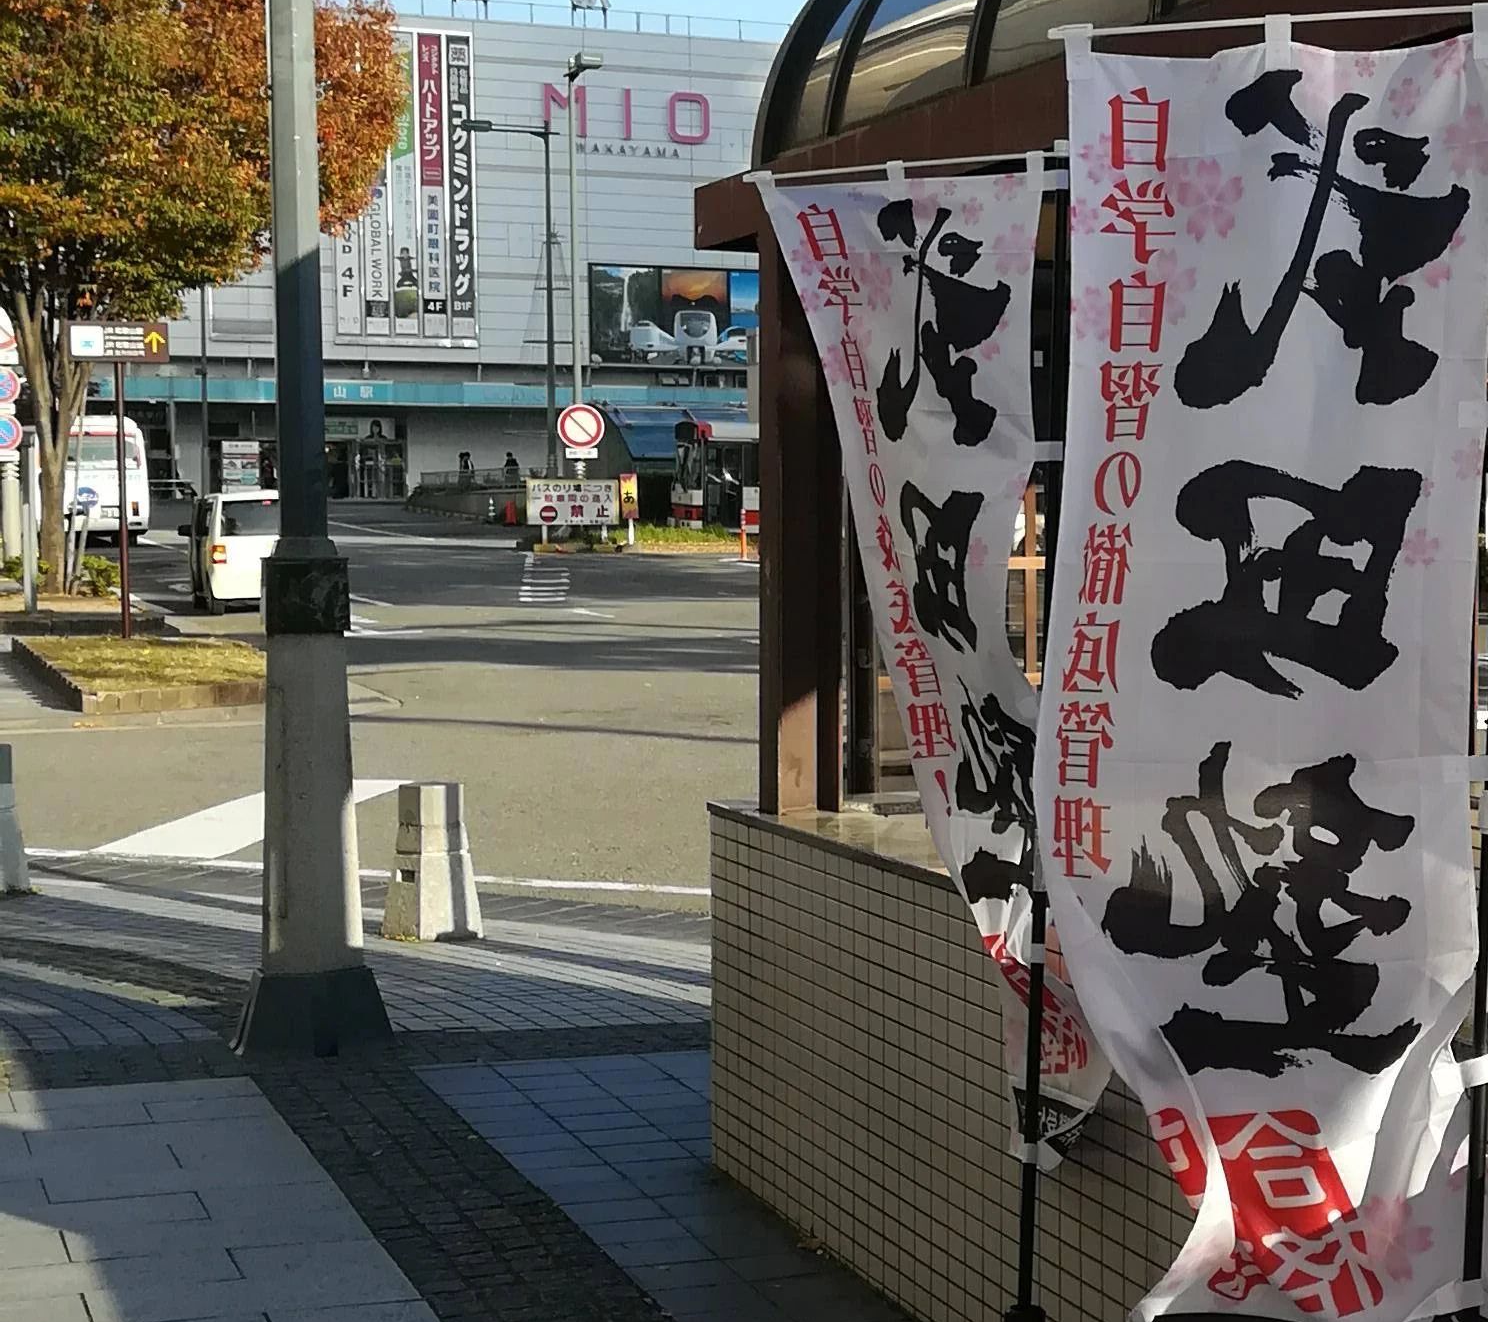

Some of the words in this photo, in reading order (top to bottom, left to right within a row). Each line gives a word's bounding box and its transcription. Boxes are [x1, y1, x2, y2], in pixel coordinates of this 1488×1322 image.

[421, 79, 441, 160] ハートアップ
[541, 83, 711, 145] MIO
[575, 142, 680, 159] WAKAYAMA
[451, 104, 472, 296] コクミンドラッグ
[368, 202, 382, 256] GLOBAL
[371, 258, 384, 298] WORK
[427, 301, 443, 311] 4F
[453, 300, 472, 311] B1F
